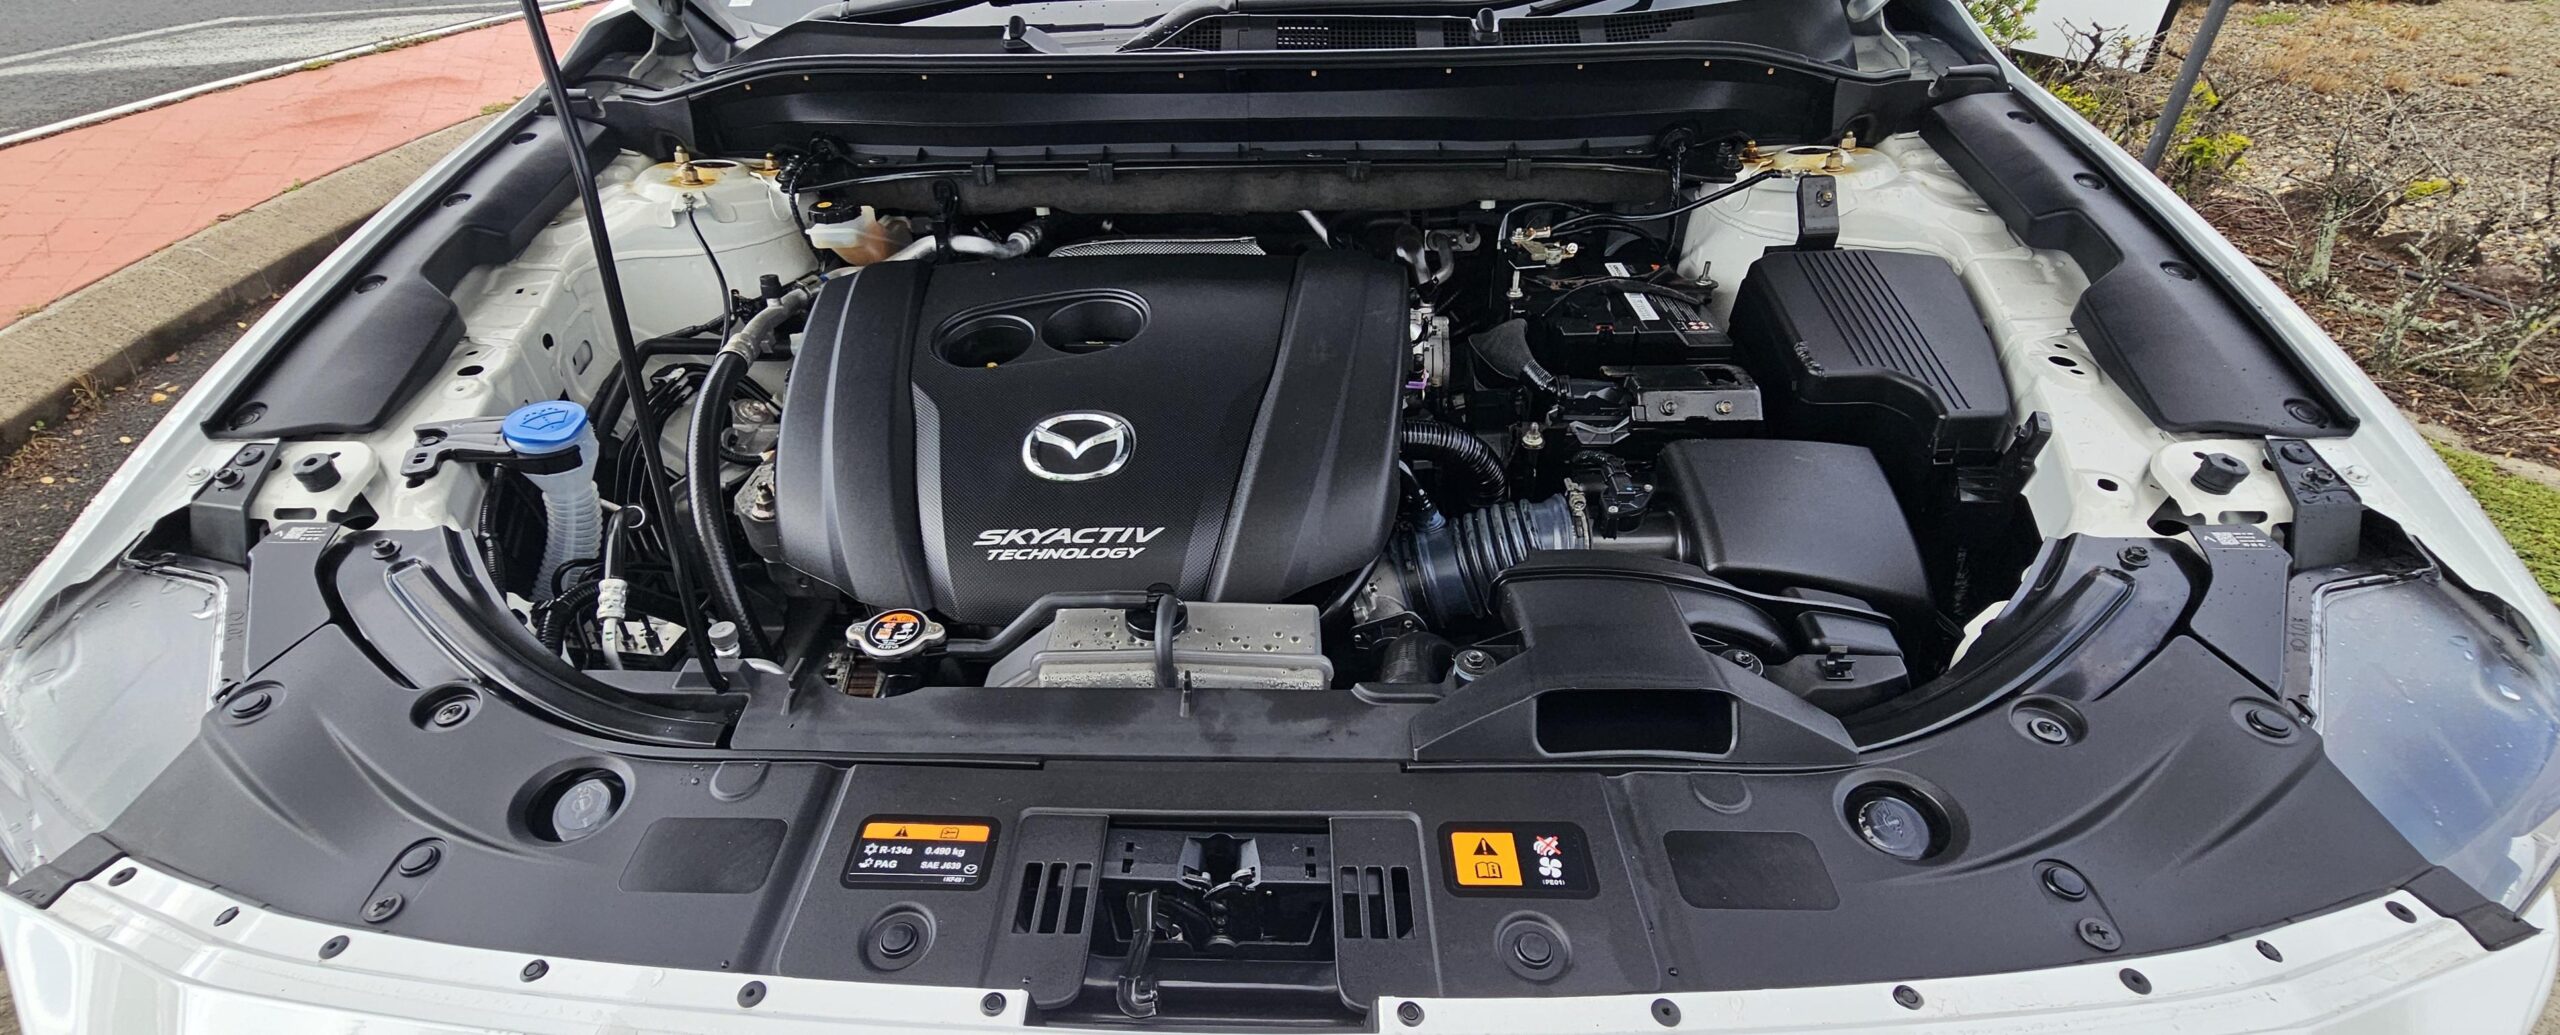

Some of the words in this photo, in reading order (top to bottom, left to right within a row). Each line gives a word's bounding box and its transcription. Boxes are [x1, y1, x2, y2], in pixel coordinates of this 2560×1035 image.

[973, 527, 1165, 546] SKYACTIV
[988, 548, 1146, 561] TECHNOLOGY
[879, 846, 913, 855] R-134a
[924, 846, 951, 856] 0.490
[952, 847, 965, 858] kg
[874, 860, 898, 869] PAG
[920, 861, 939, 869] SAE
[940, 862, 962, 870] J639
